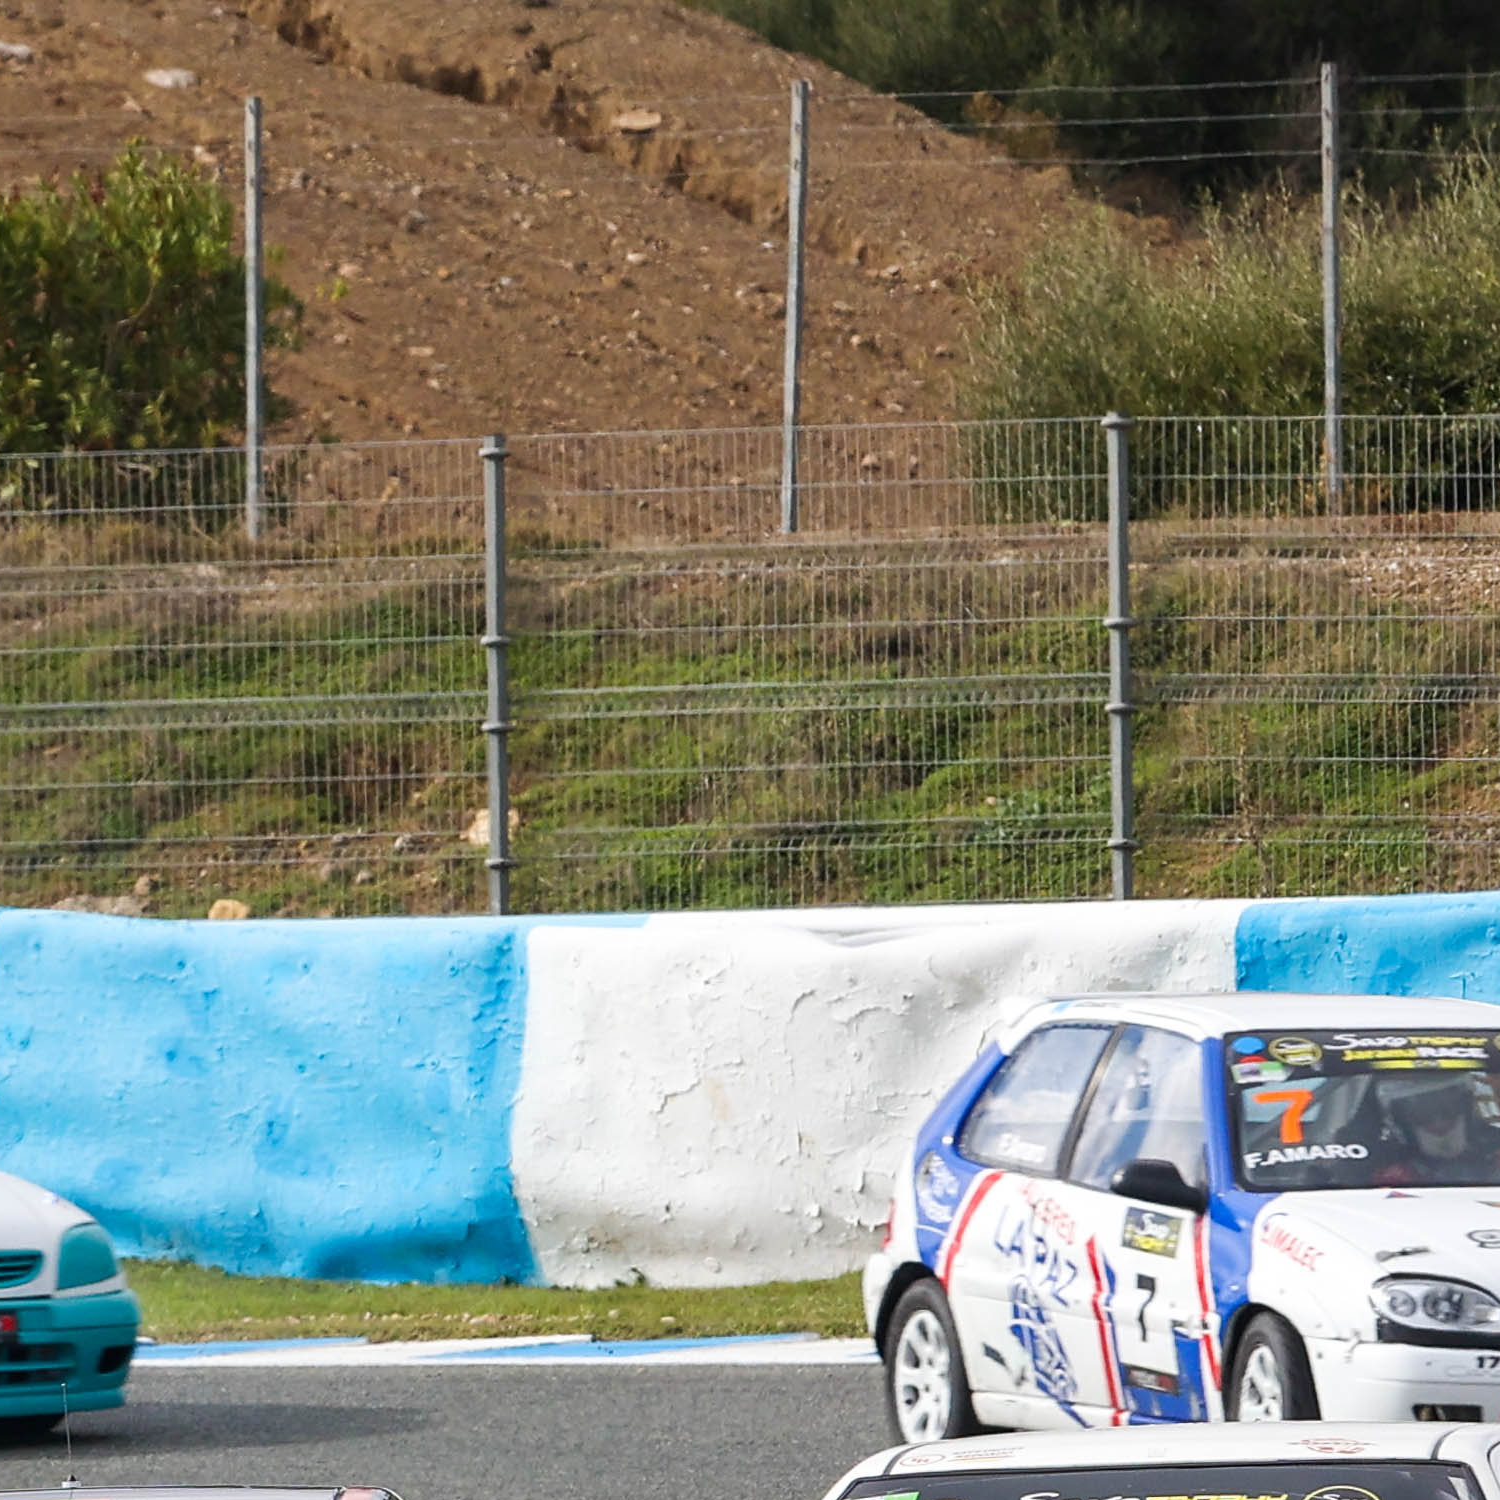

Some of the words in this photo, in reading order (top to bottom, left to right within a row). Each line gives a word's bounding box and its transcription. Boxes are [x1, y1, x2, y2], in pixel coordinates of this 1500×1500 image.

[1323, 1033, 1408, 1050] Saxo
[1254, 1090, 1313, 1143] 7
[1244, 1144, 1368, 1169] F.AMARO
[1136, 1273, 1156, 1342] 7
[1477, 1356, 1500, 1369] 17
